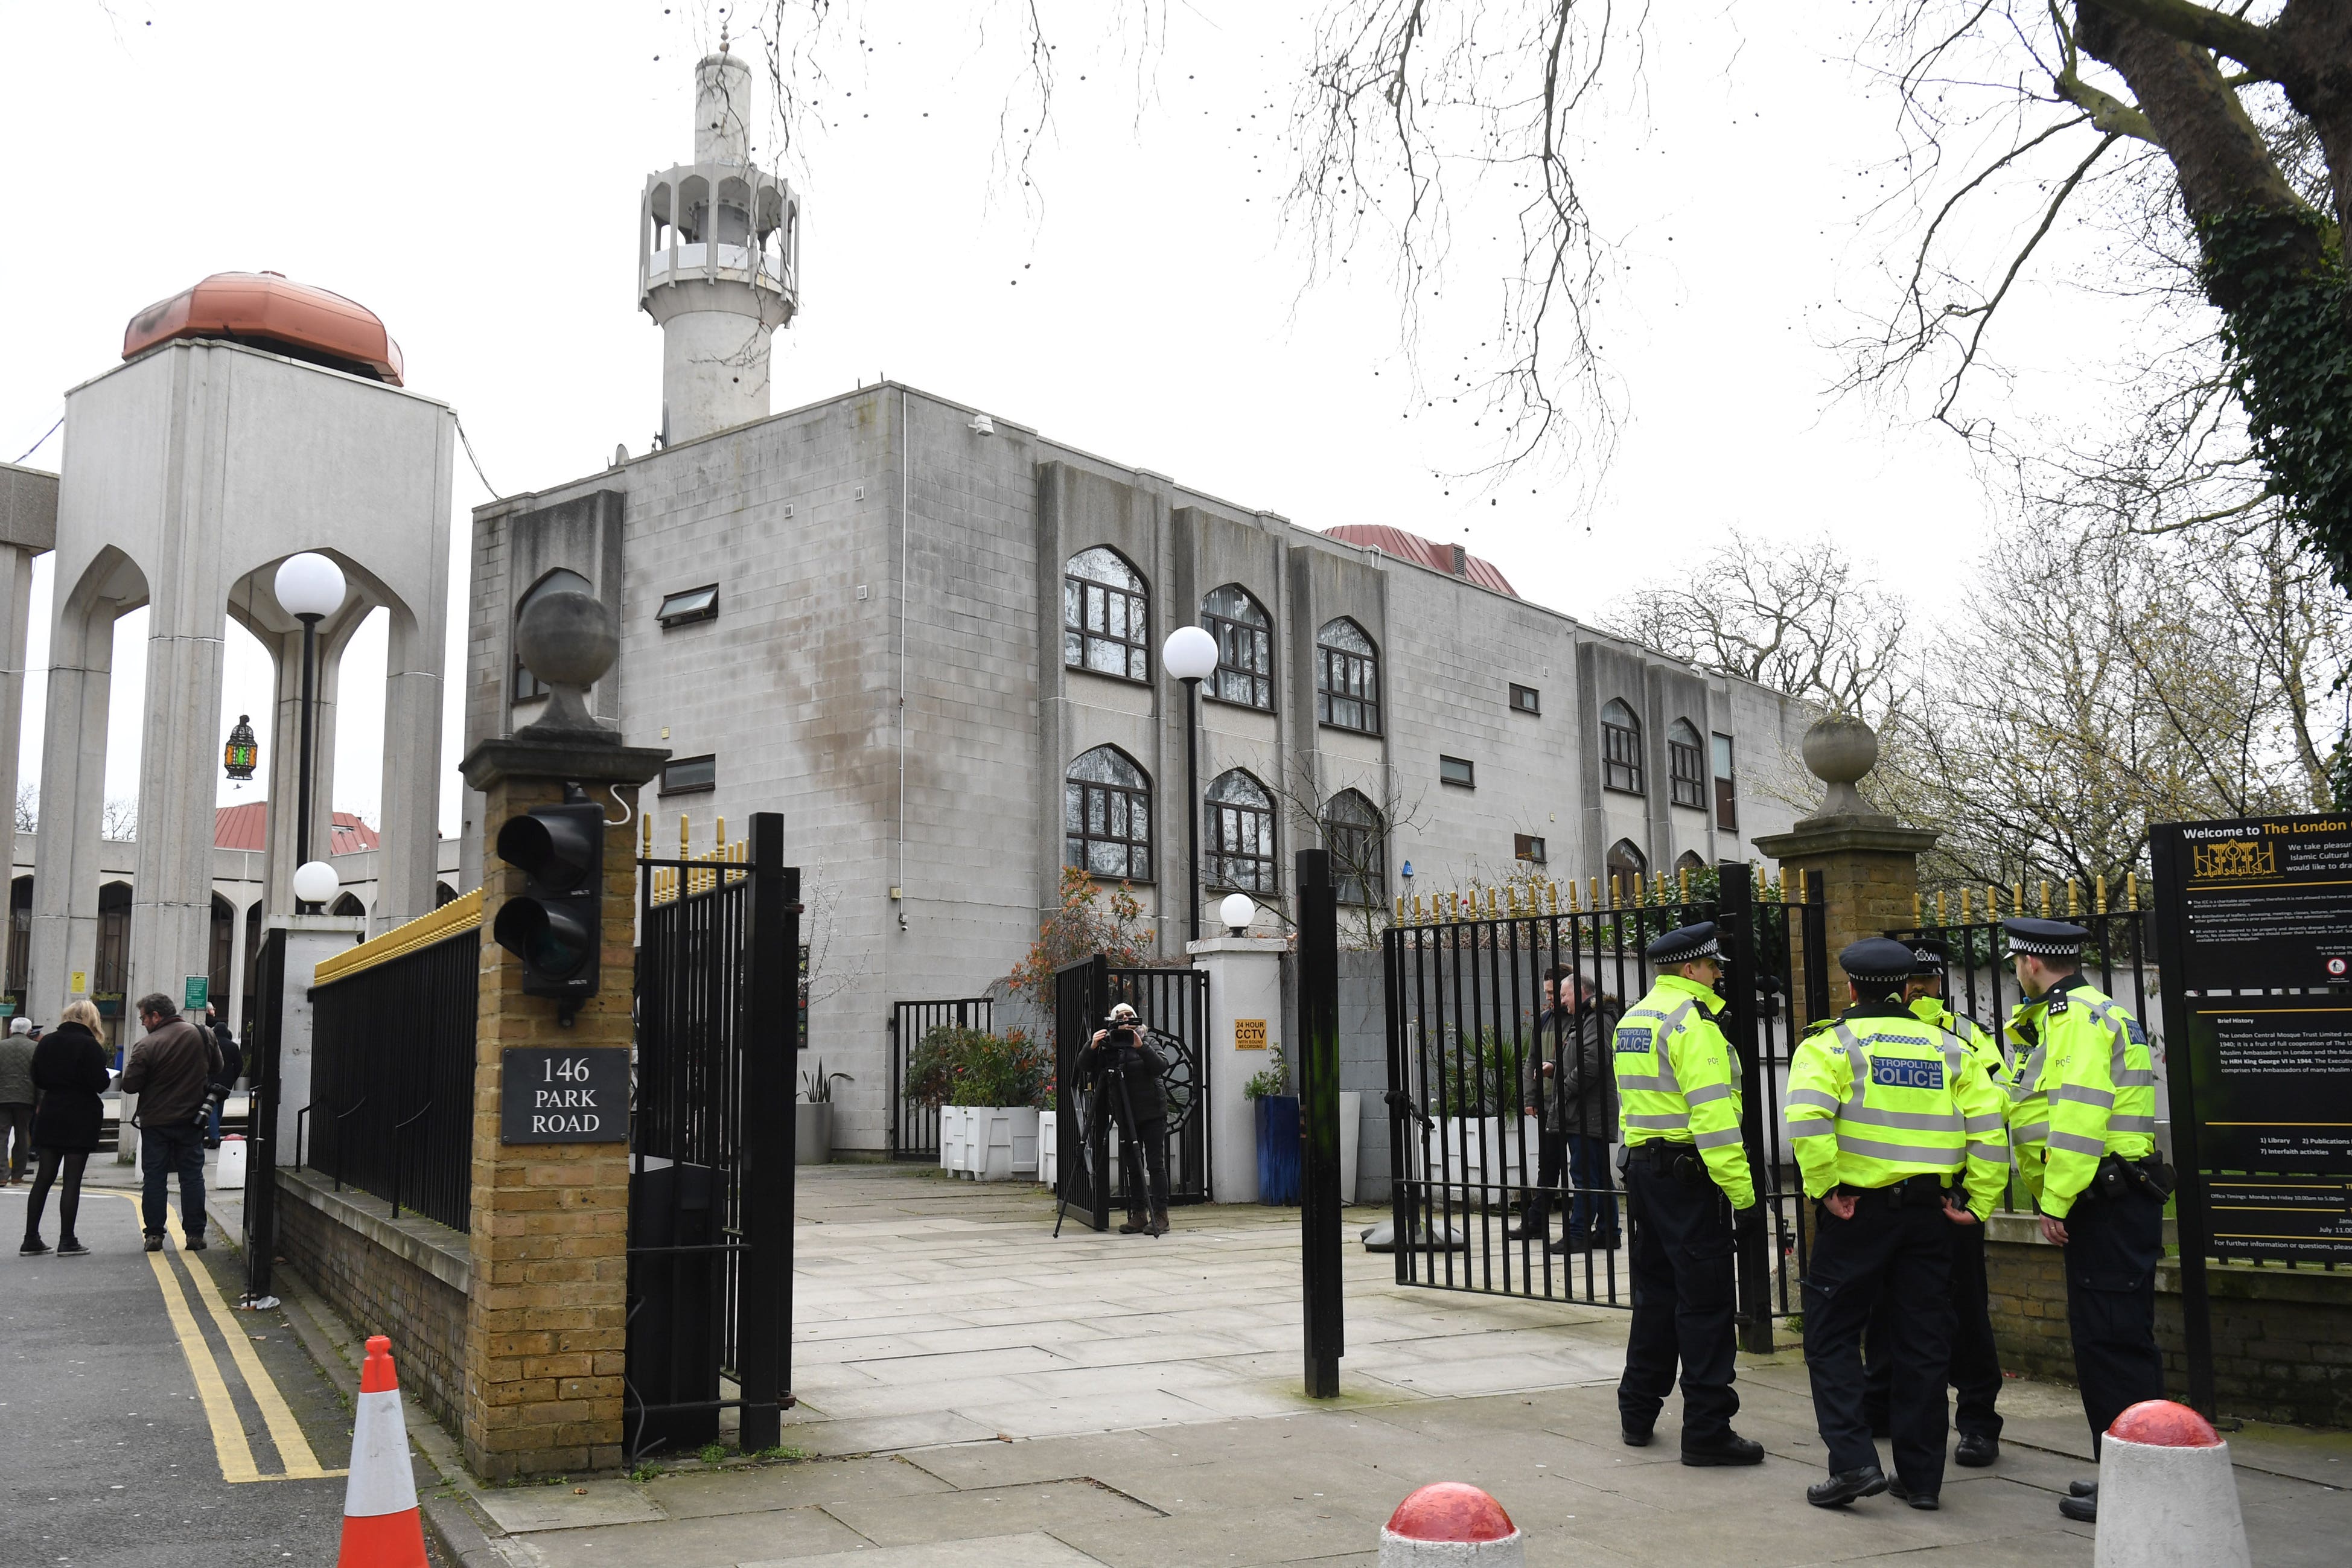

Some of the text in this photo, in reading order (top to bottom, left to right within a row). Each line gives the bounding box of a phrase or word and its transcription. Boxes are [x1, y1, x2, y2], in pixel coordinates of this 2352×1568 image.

[2183, 827, 2243, 839] Welcome
[2246, 826, 2260, 835] to
[2262, 823, 2289, 834] The
[2293, 820, 2347, 833] London
[1235, 1029, 1265, 1039] CCTV
[1616, 1037, 1651, 1051] POLICE
[543, 1057, 590, 1082] 146
[1872, 1068, 1942, 1087] POLICE
[534, 1089, 598, 1107] PARK
[531, 1114, 600, 1133] ROAD
